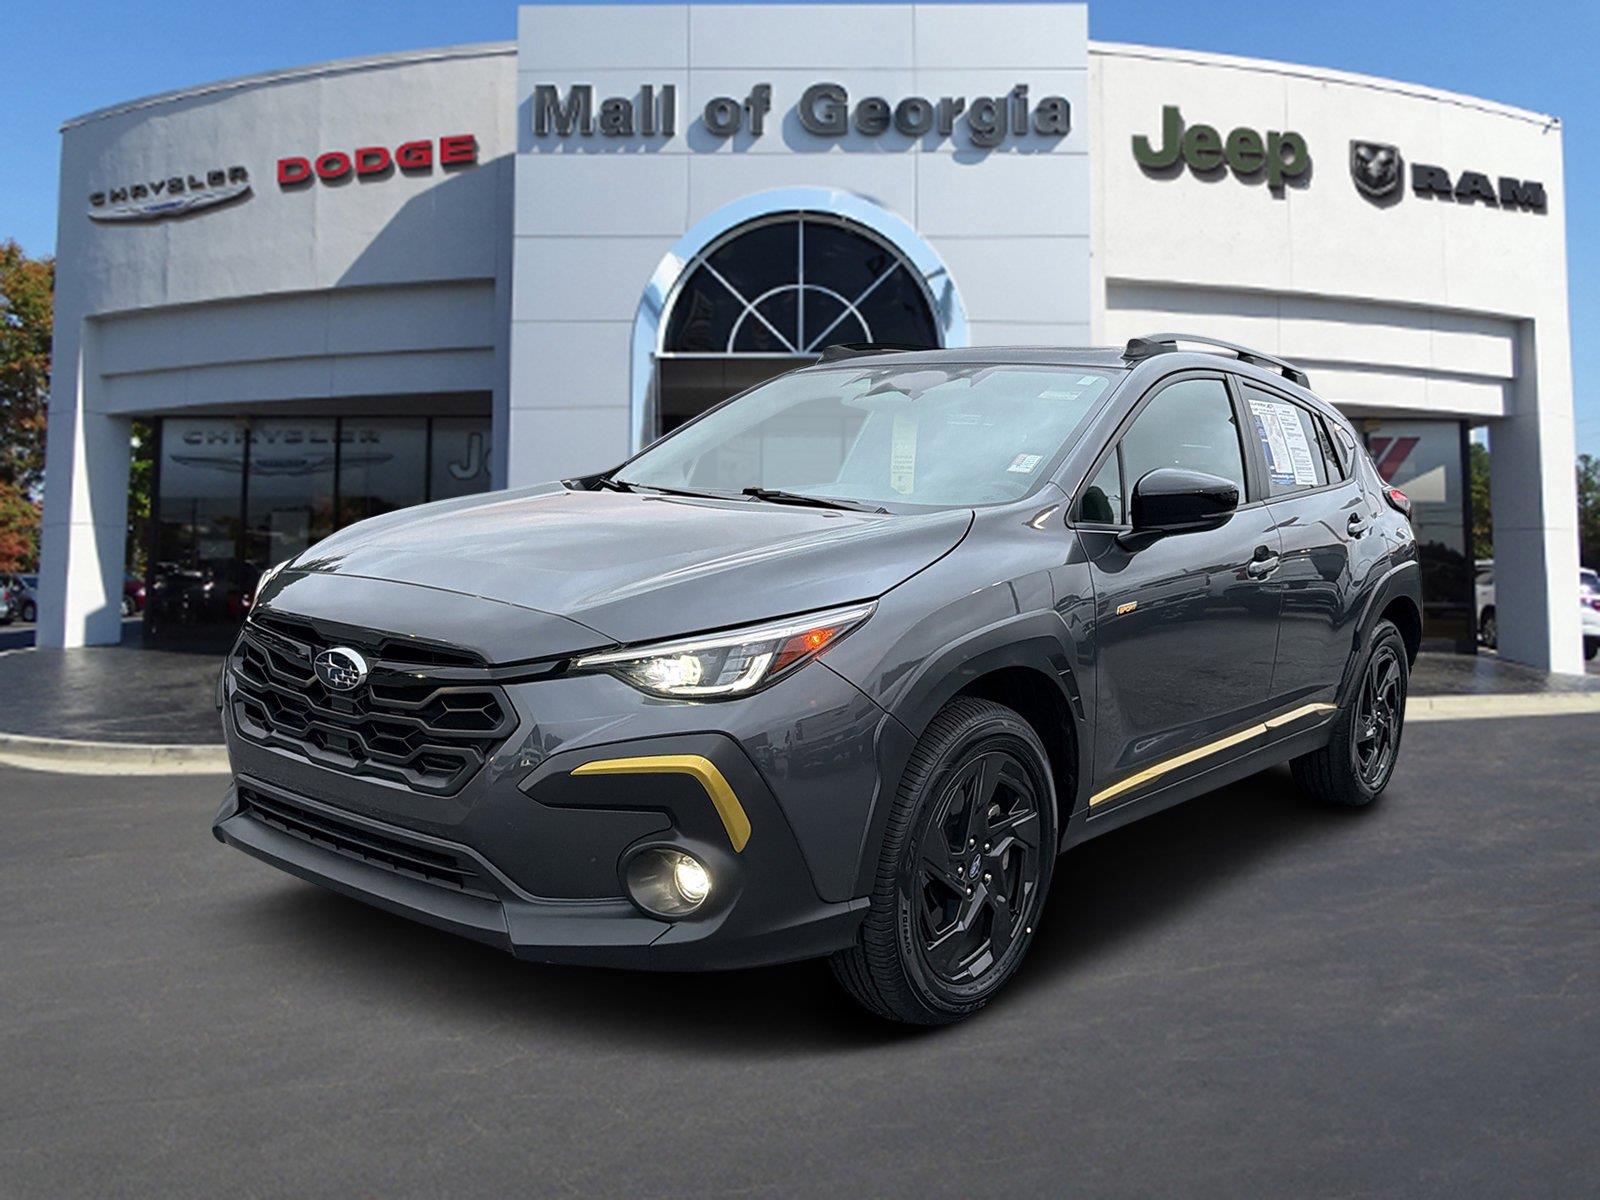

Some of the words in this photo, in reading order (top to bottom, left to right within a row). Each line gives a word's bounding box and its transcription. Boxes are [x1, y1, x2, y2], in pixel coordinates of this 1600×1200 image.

[534, 84, 675, 136] Mall
[704, 83, 772, 136] of
[799, 82, 1072, 147] Georgia
[278, 134, 477, 186] DODGE
[1132, 105, 1310, 194] Jeep
[89, 166, 249, 206] CHRYSLER
[1411, 163, 1548, 213] RAM
[183, 429, 380, 444] CHRYSLER
